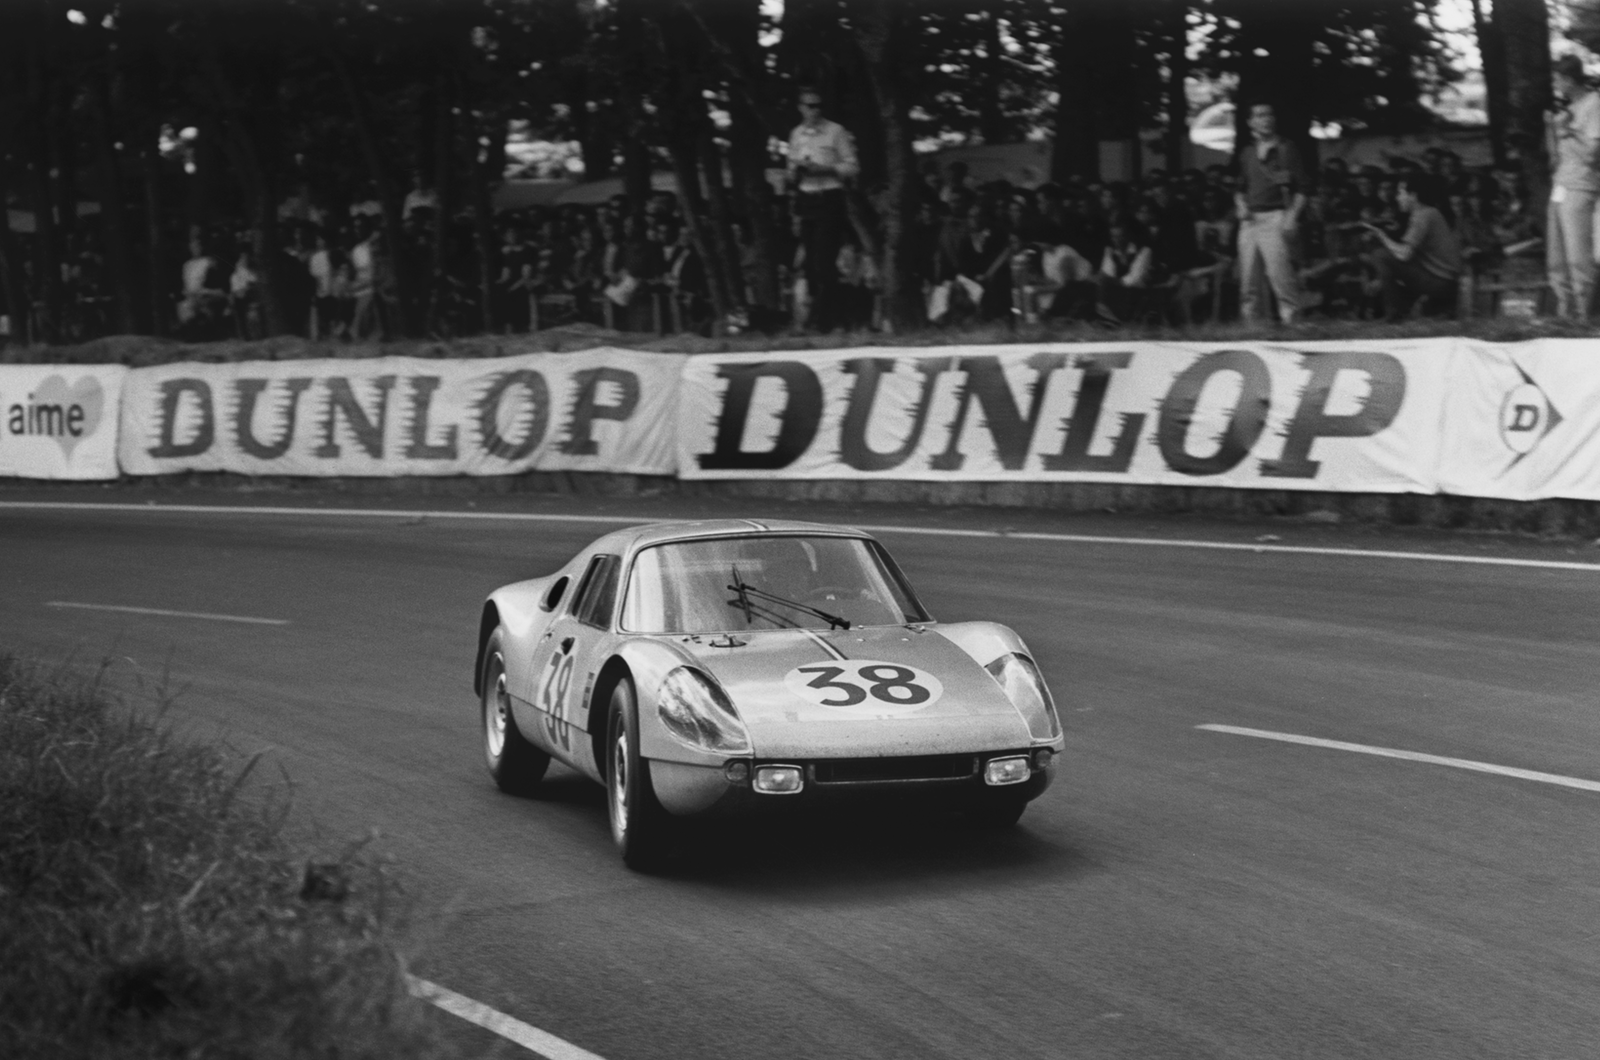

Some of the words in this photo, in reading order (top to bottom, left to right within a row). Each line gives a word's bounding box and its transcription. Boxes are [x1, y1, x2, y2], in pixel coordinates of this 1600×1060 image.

[9, 392, 84, 437] aime
[147, 367, 640, 461] DUNLOP
[697, 350, 1407, 478] DUNLOP
[1507, 403, 1540, 432] D
[543, 651, 574, 752] 38
[797, 664, 931, 707] 38
